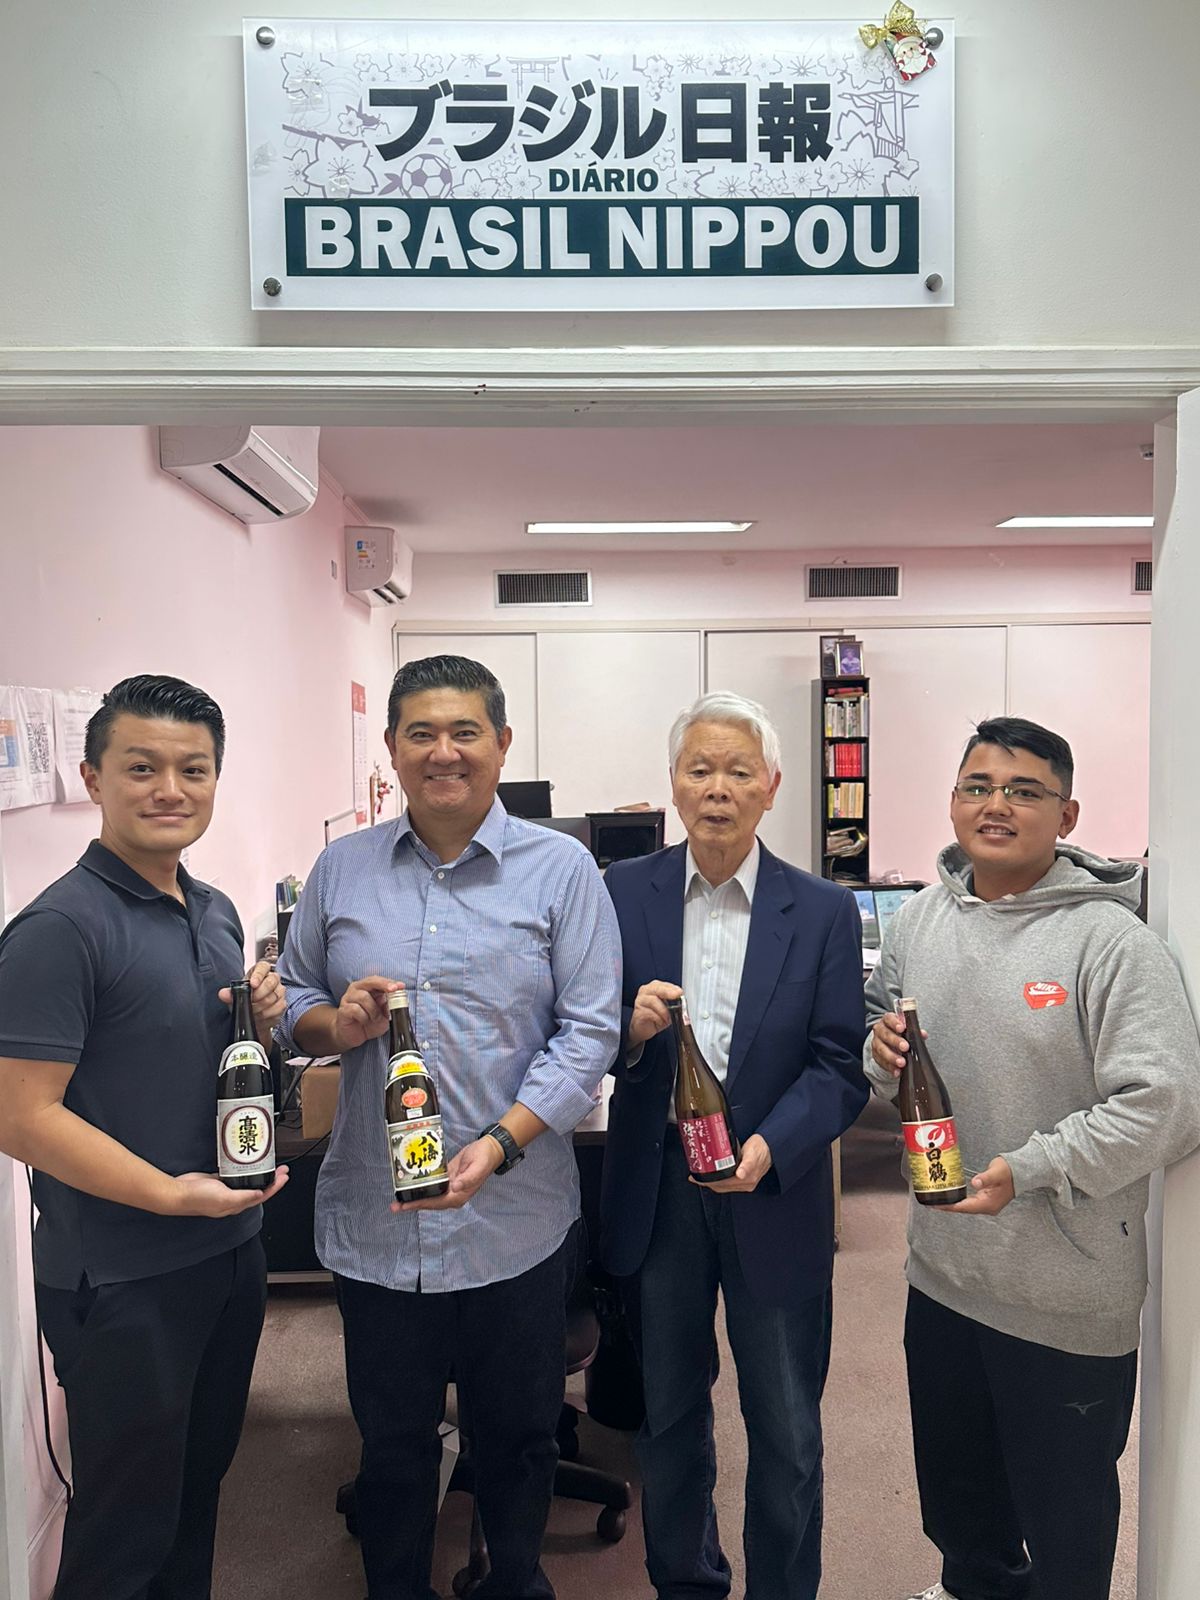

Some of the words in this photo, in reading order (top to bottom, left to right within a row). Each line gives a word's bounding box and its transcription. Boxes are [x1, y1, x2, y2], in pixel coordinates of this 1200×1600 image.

[549, 165, 658, 193] DIÁRIO
[306, 205, 591, 270] BRASIL
[609, 204, 900, 270] NIPPOU
[1034, 982, 1059, 993] NIKE
[926, 1142, 947, 1182] 白鶴
